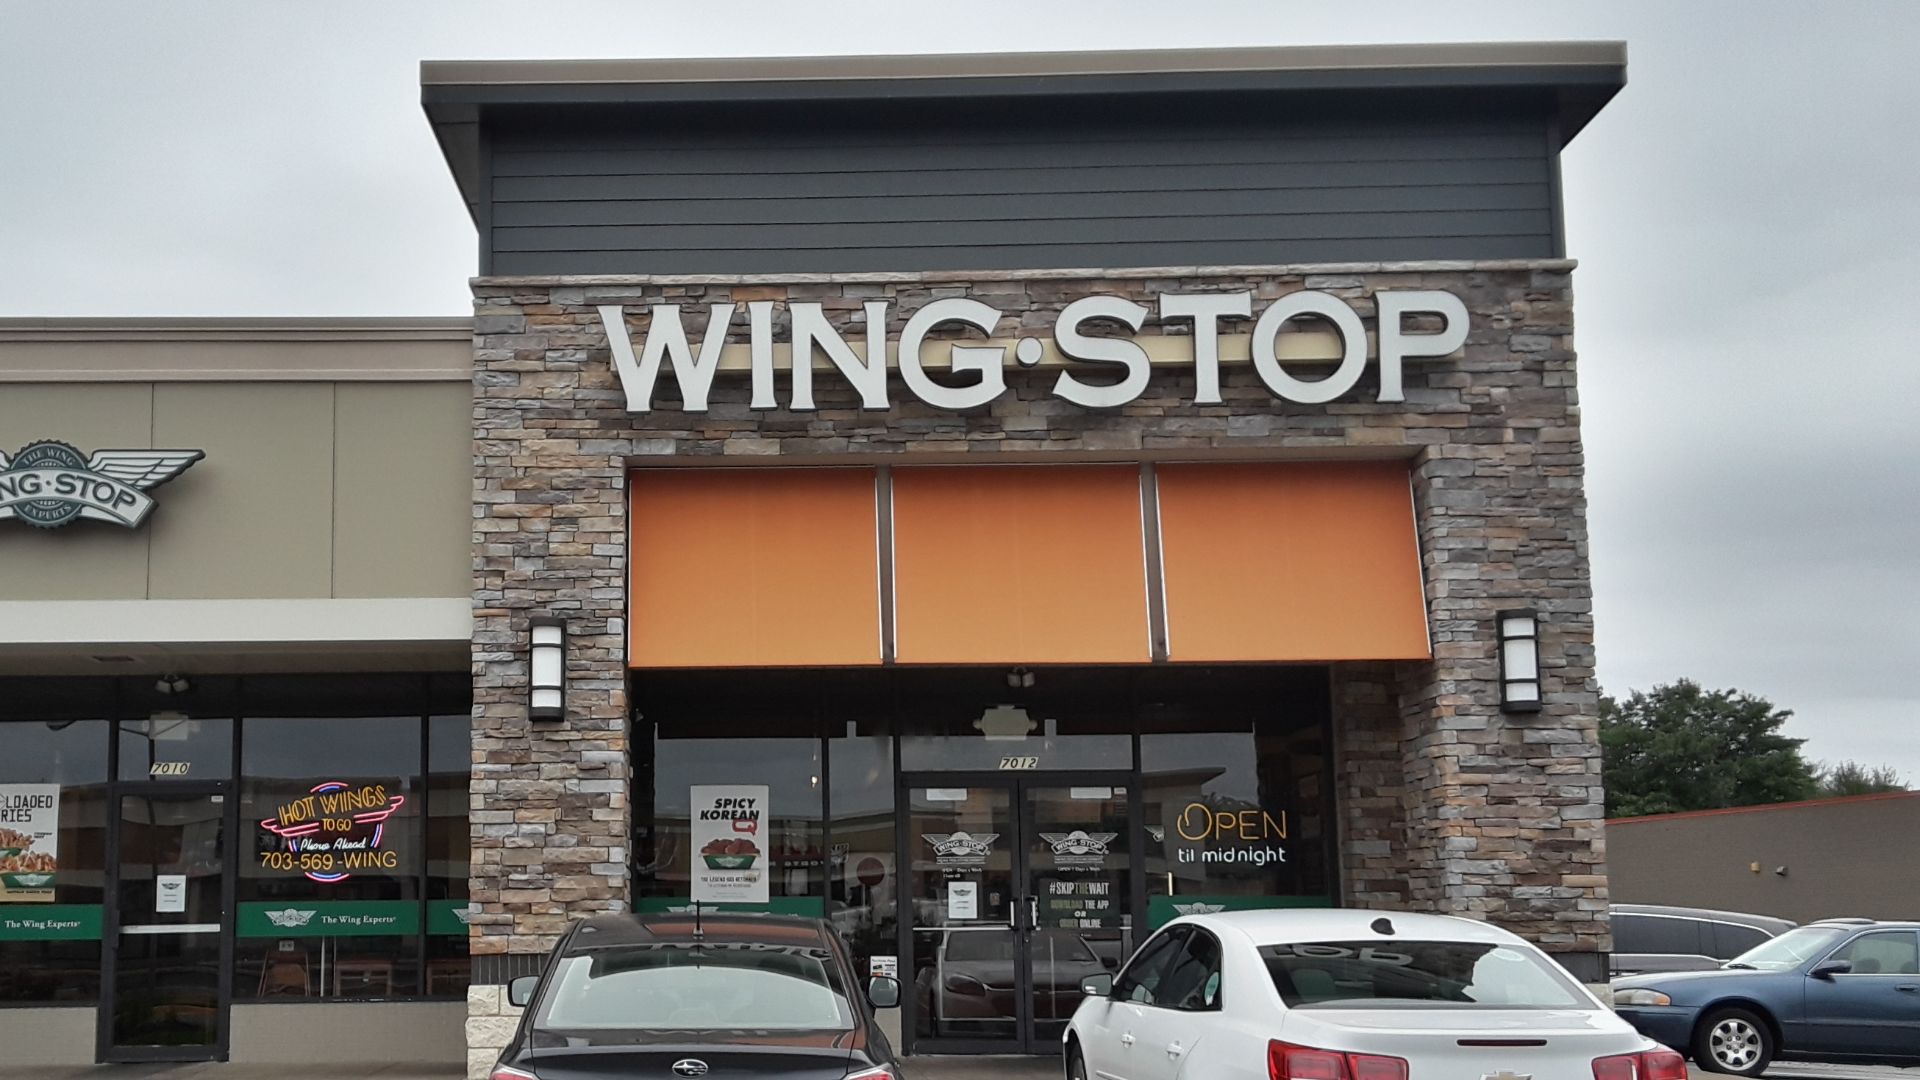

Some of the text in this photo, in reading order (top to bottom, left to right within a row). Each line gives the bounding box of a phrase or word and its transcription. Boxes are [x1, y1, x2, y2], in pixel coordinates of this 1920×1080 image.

[23, 447, 76, 466] THE WING
[24, 504, 72, 519] EXPERTS
[152, 763, 188, 774] 7010
[1001, 758, 1037, 769] 7012
[6, 794, 53, 809] LOADED
[278, 785, 387, 826] HOT WINGS
[714, 798, 757, 809] SPICY
[700, 809, 760, 821] KOREAN
[322, 818, 352, 831] TO GO
[732, 818, 758, 836] Q
[300, 837, 367, 851] Phone Ahead
[1178, 845, 1287, 866] til midnight
[1085, 899, 1096, 910] THE
[1097, 899, 1110, 910] APP
[5, 920, 21, 928] The
[22, 919, 45, 930] Wing
[320, 915, 337, 924] The
[338, 915, 361, 926] Wing
[1079, 918, 1101, 928] ONLINE
